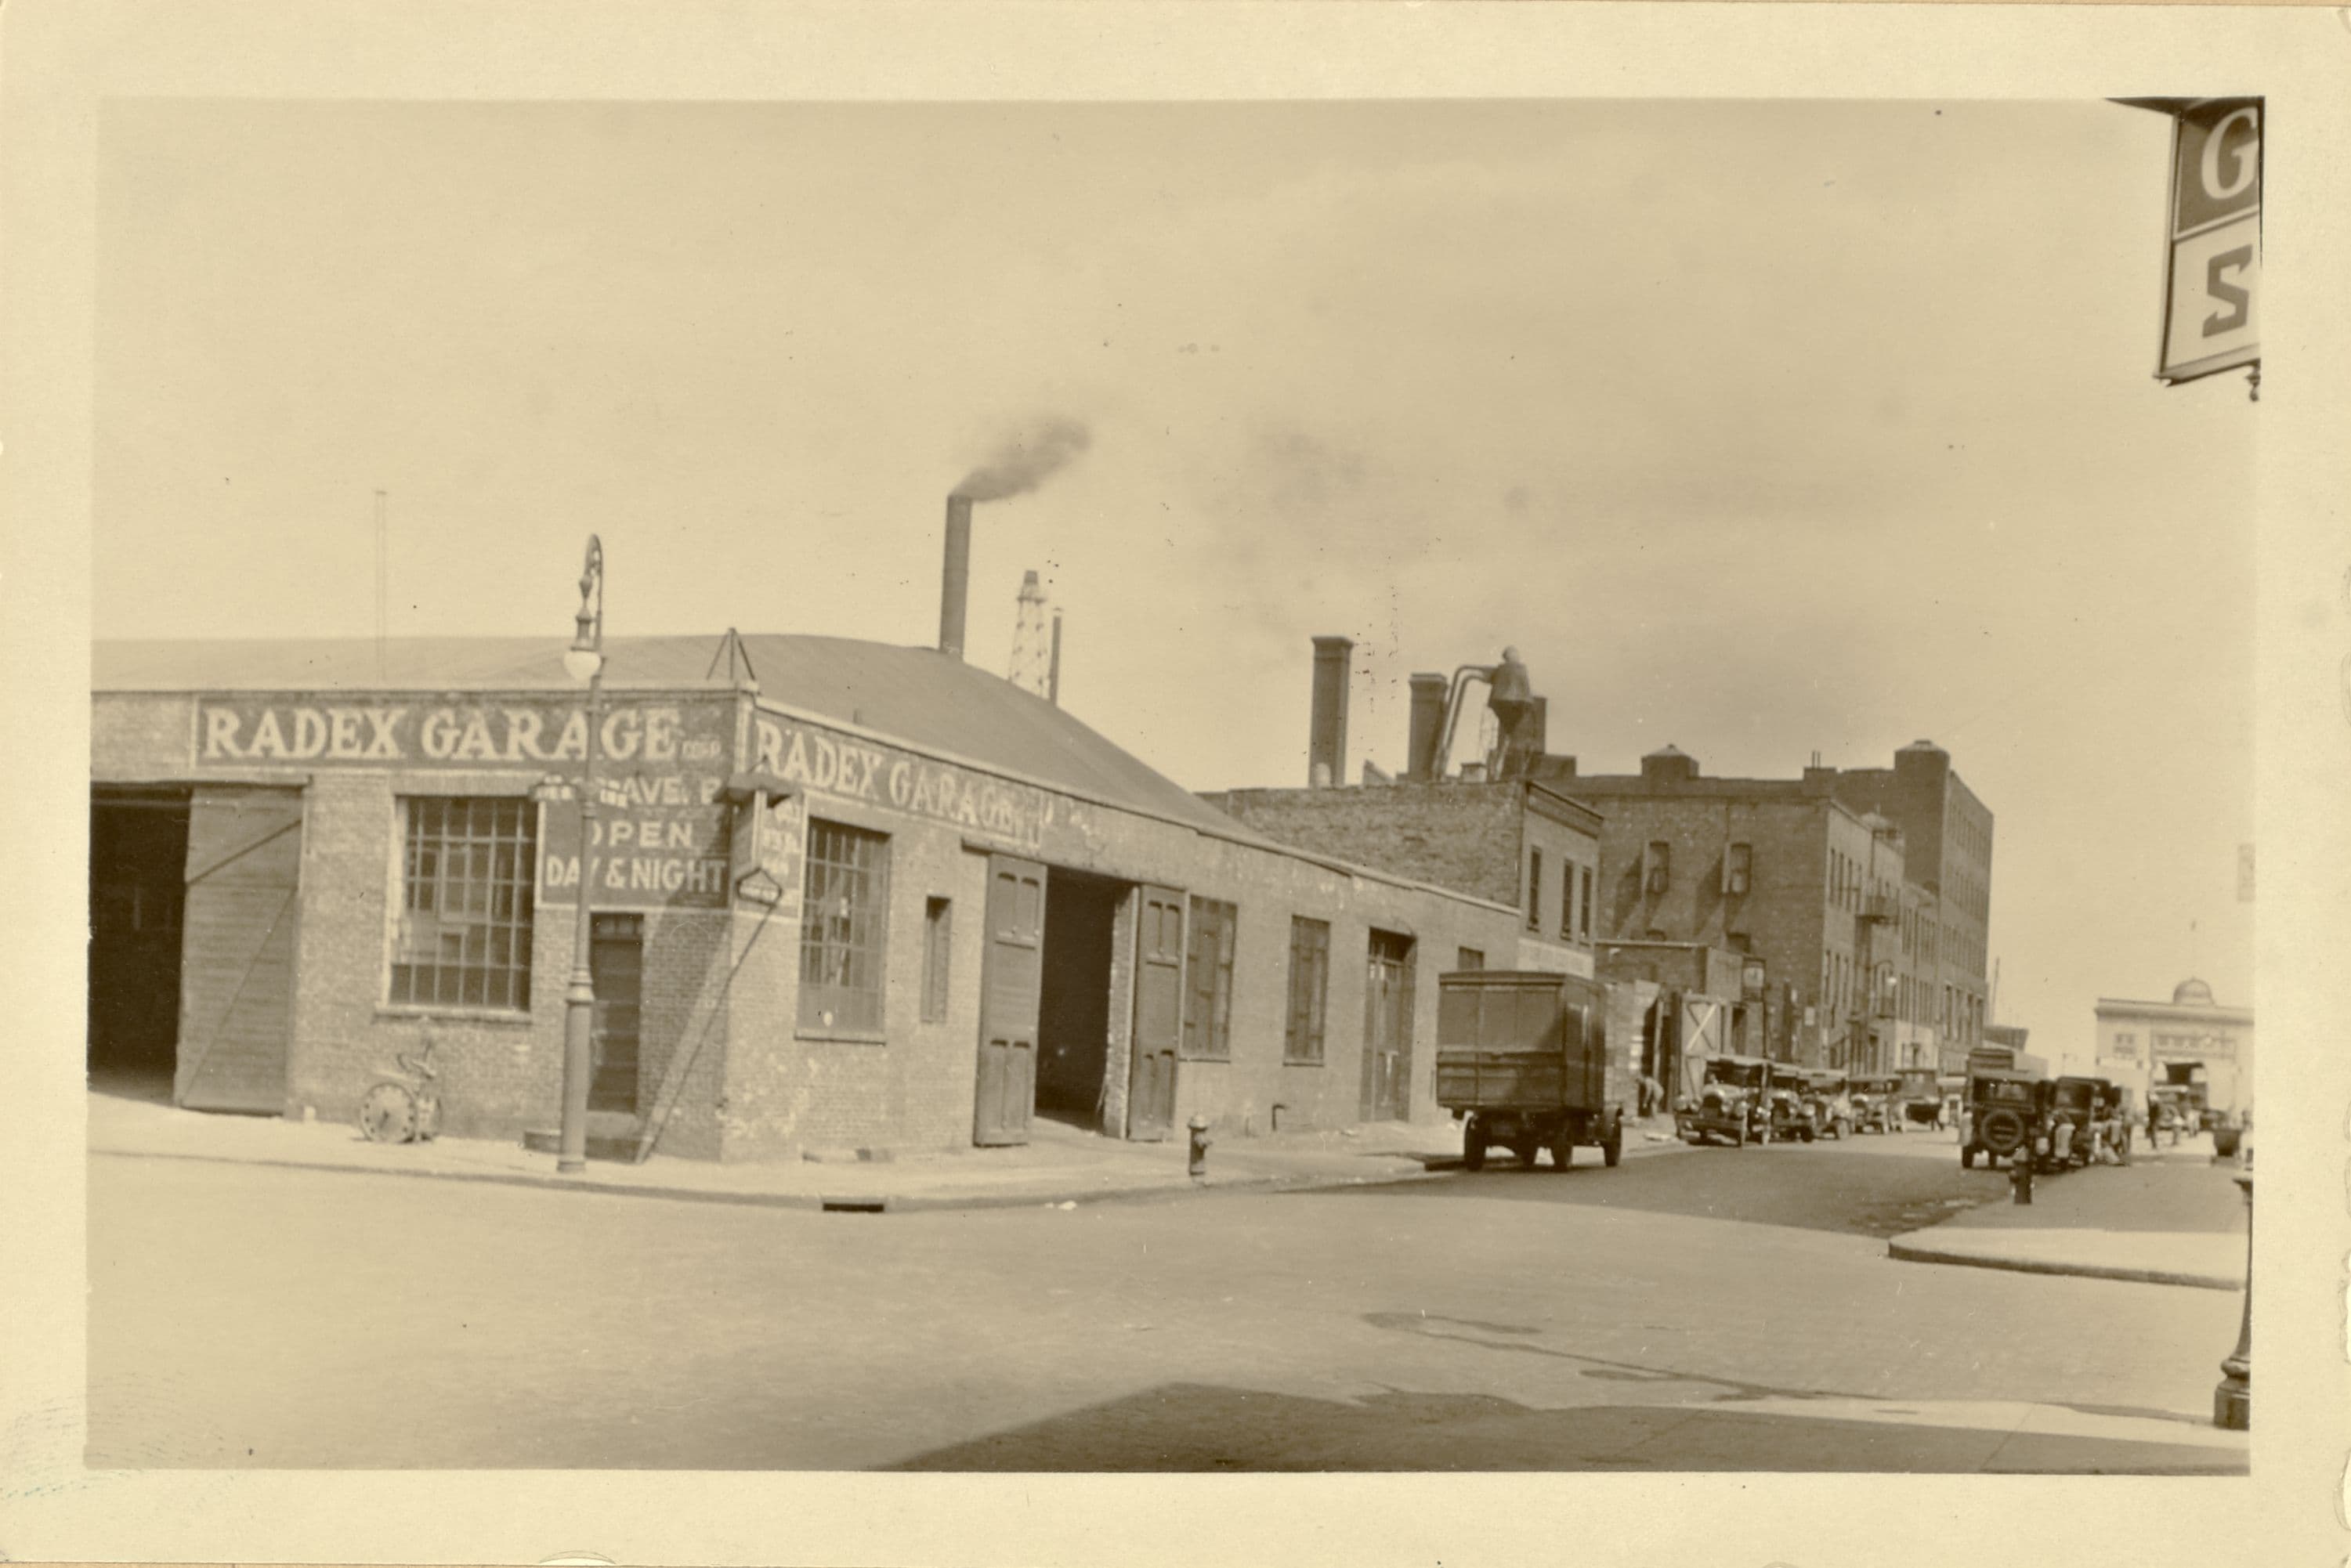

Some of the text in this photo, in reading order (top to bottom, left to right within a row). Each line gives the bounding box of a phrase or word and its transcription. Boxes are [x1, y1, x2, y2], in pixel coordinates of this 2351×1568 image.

[2202, 244, 2252, 338] S
[203, 706, 407, 760] RADEX
[421, 706, 680, 761] GARAGE
[757, 719, 881, 799] RADEX
[606, 860, 625, 889] &
[631, 858, 727, 894] NIGHT
